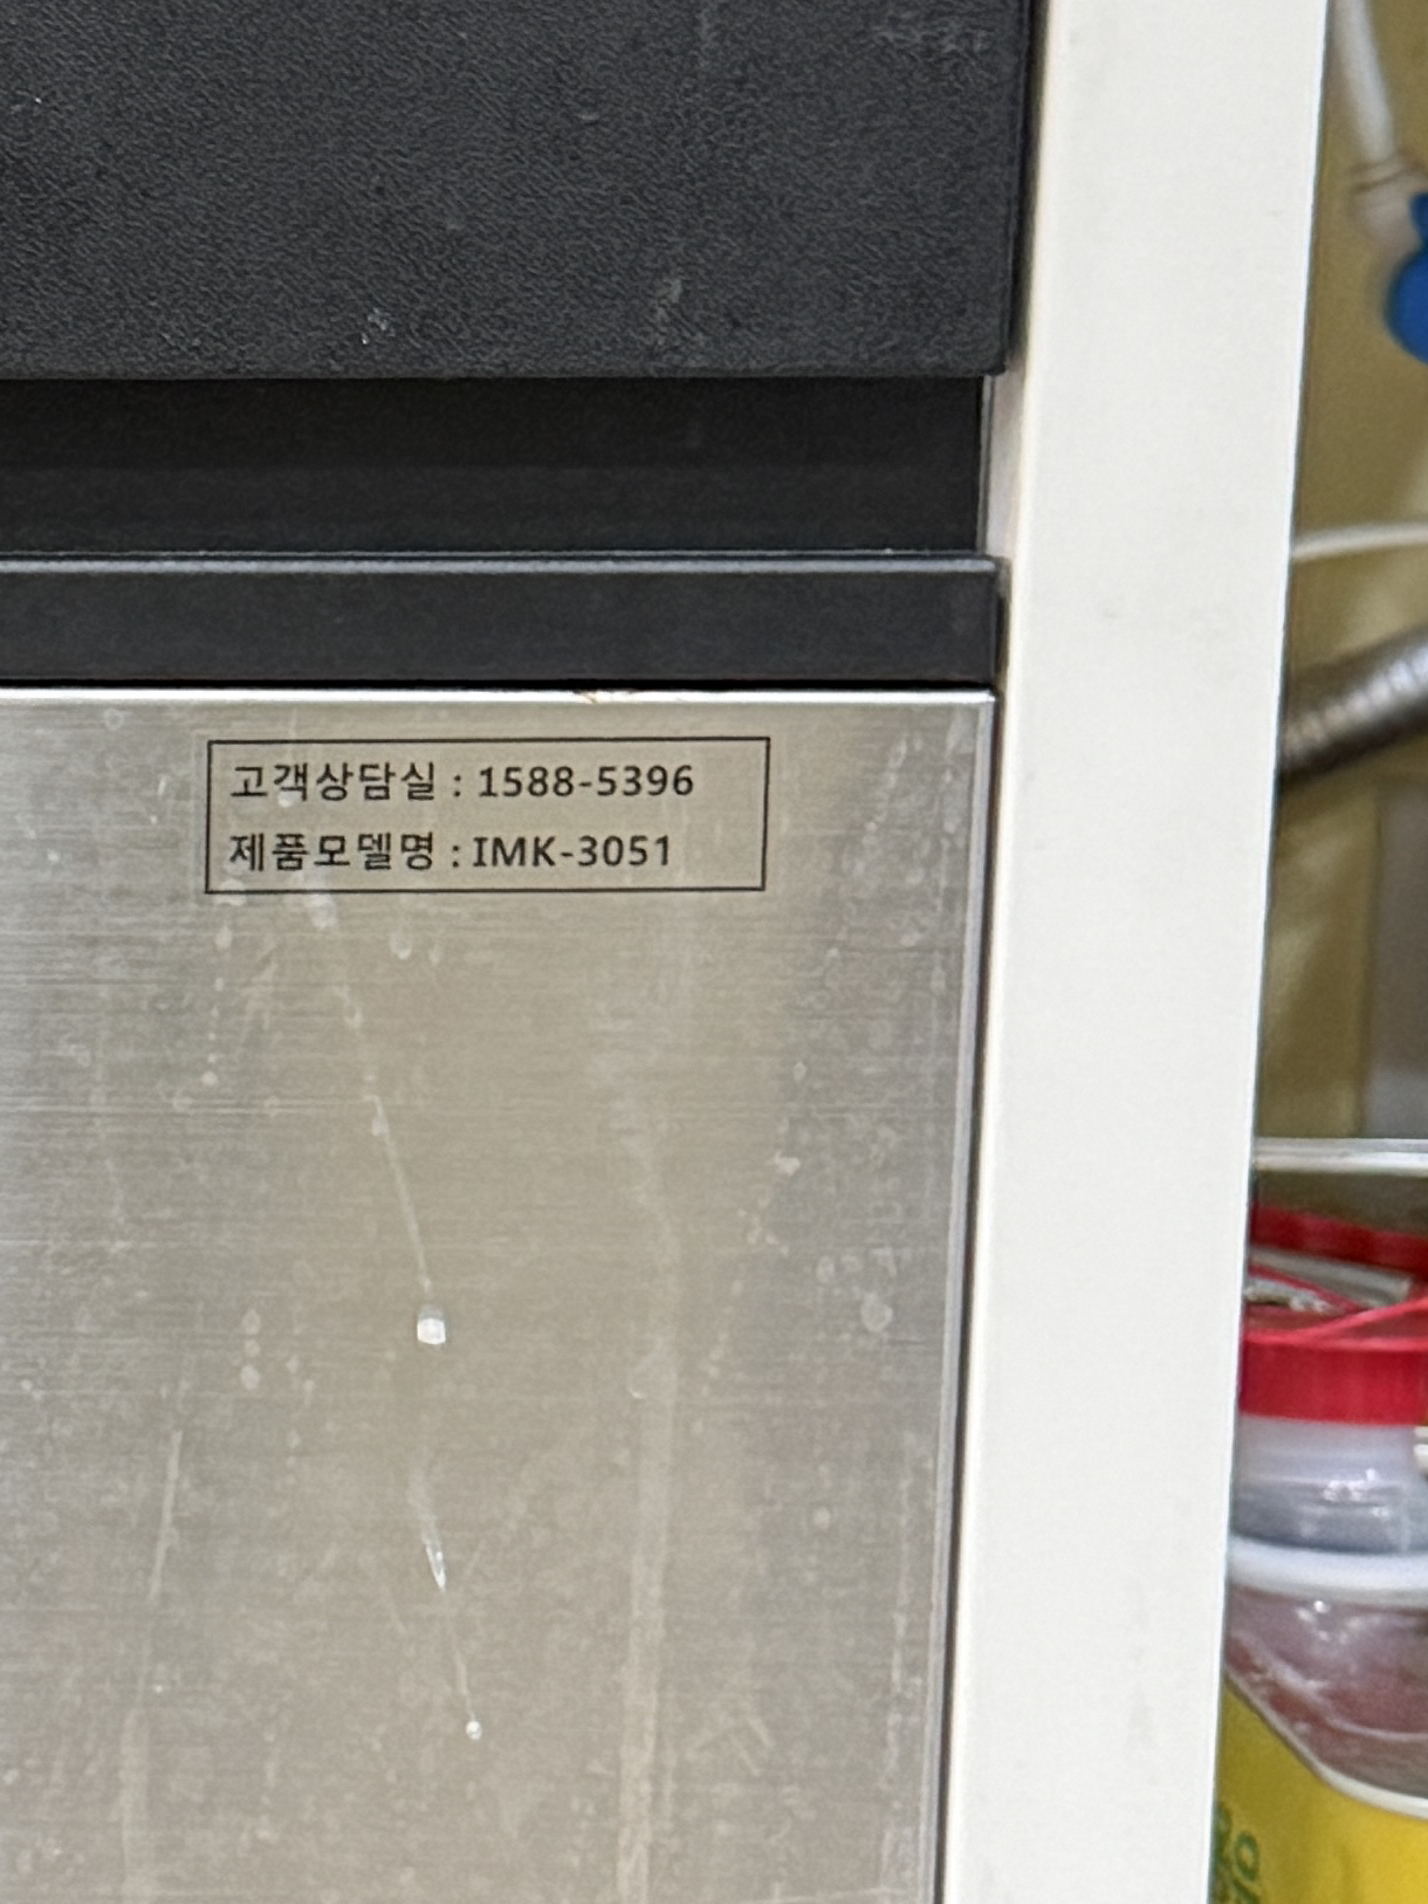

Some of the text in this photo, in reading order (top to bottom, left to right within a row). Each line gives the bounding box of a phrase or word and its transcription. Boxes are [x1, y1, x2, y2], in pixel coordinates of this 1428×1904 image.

[230, 761, 436, 802] 고객상담실
[478, 764, 694, 798] 1588-5396
[229, 831, 435, 872] 제품모델명
[472, 834, 671, 868] IMK-3051
